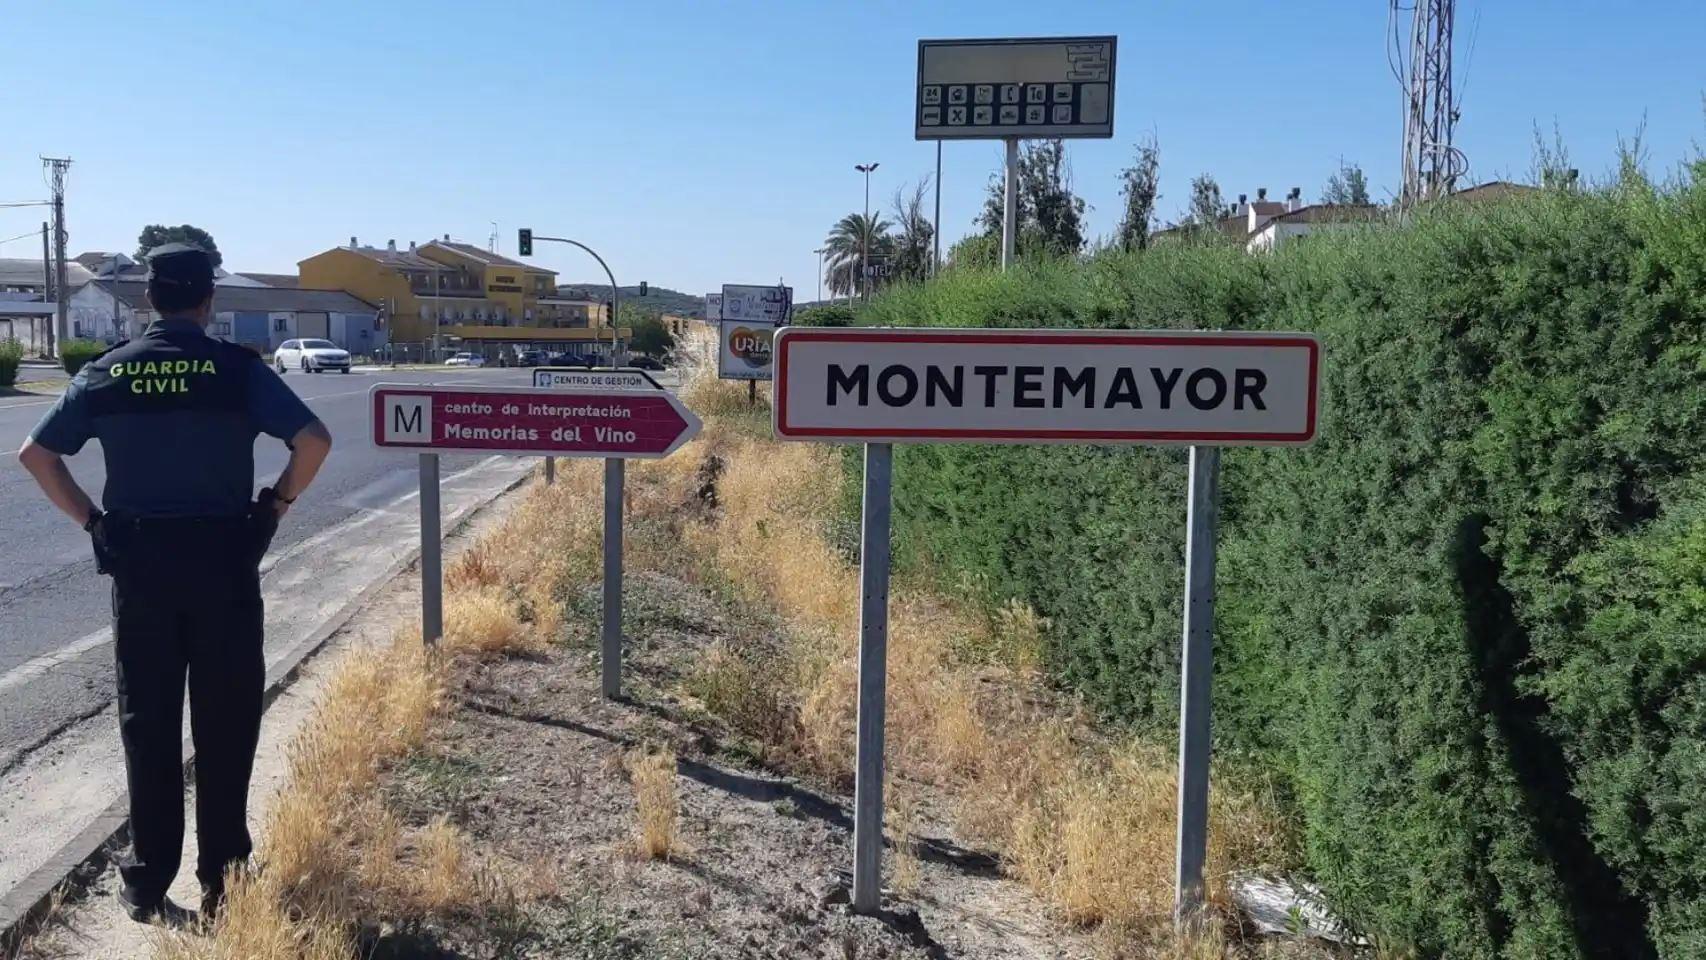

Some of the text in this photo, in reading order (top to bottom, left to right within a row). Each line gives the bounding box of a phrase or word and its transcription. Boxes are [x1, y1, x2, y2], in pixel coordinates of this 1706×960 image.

[131, 378, 189, 394] CIVIL
[554, 375, 589, 386] CENTRO
[591, 376, 602, 386] DE
[826, 363, 1267, 411] MONTEMAYOR
[444, 401, 492, 415] centro
[501, 403, 520, 415] de
[395, 404, 422, 434] M
[444, 423, 636, 443] Memorias del Vino
